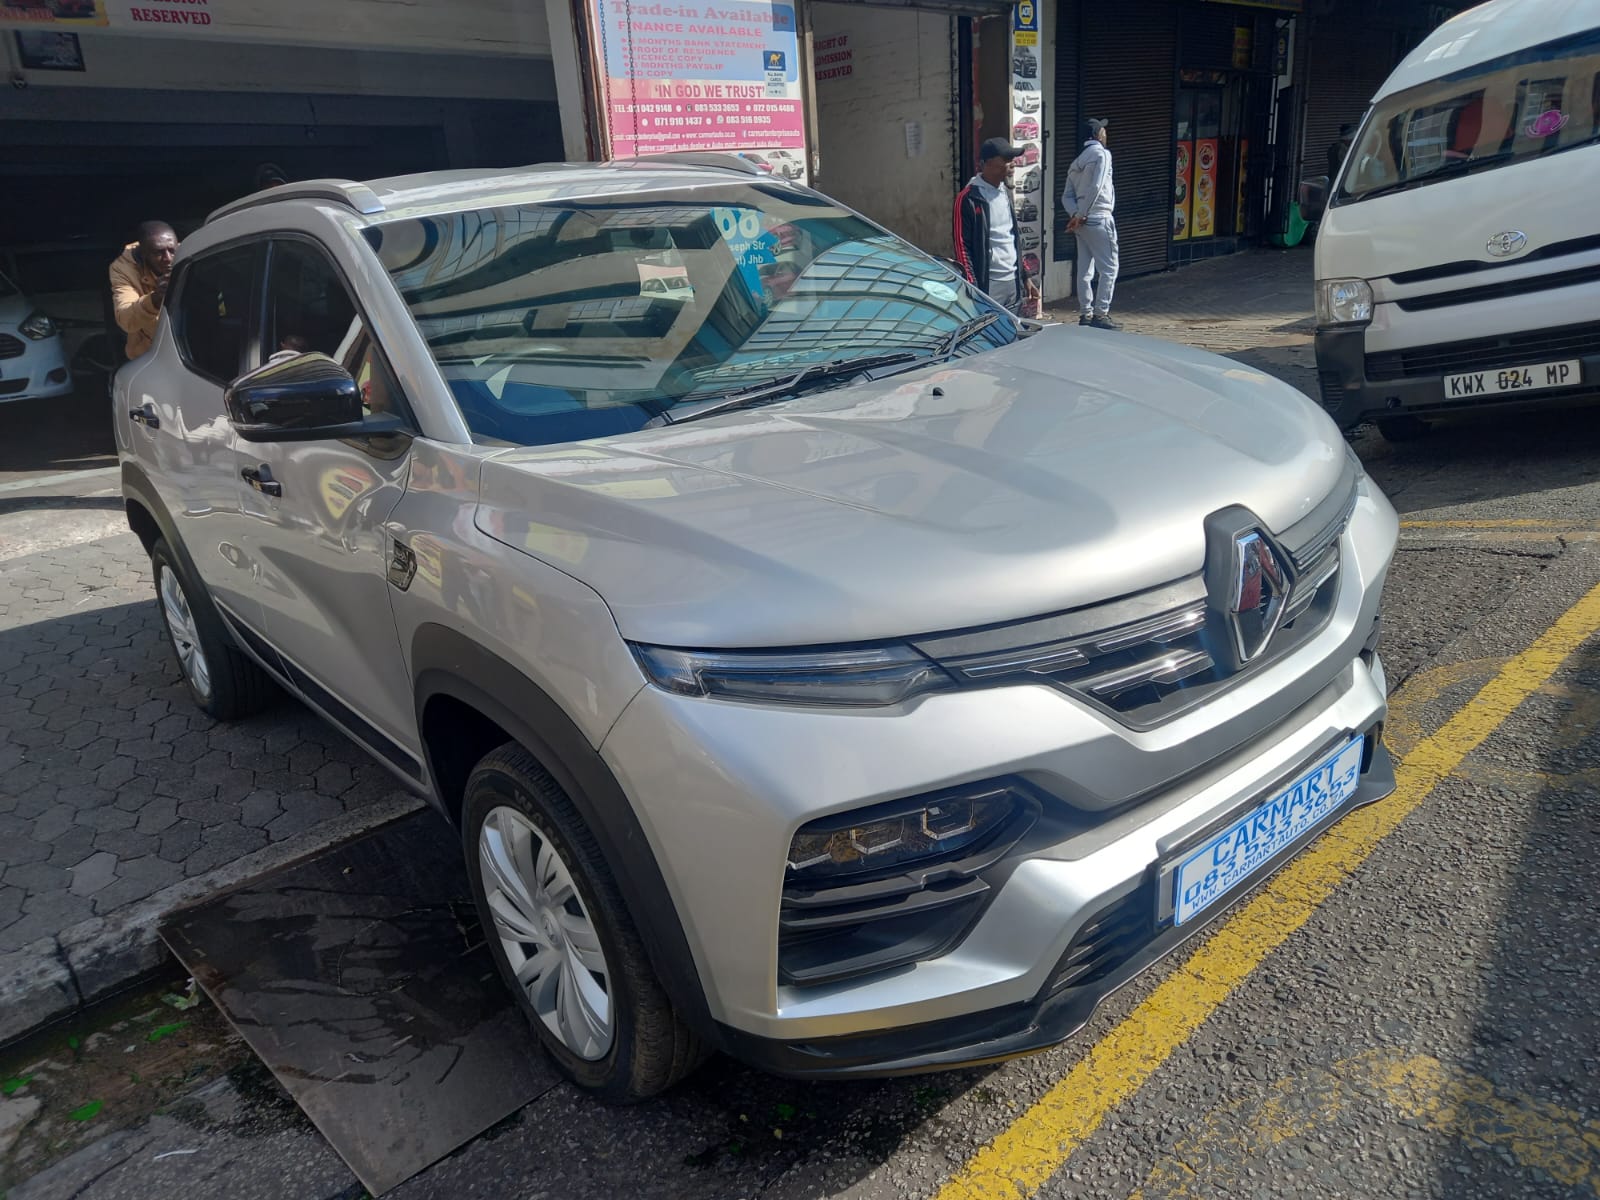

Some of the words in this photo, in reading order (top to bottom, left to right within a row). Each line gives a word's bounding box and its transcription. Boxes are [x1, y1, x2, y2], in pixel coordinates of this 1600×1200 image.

[130, 8, 211, 25] RESERVED
[704, 7, 789, 24] Available
[618, 21, 683, 32] FNANCE
[689, 25, 762, 37] AVAILABLE
[639, 38, 682, 46] MONTHS
[714, 41, 766, 50] STATEMENT
[838, 36, 848, 47] OF
[683, 48, 736, 56] RESIDENCE
[675, 85, 701, 97] GOD
[704, 85, 722, 97] WE
[728, 240, 750, 253] seph
[753, 240, 765, 250] Str
[748, 254, 763, 265] Jhb
[1451, 374, 1485, 396] KWX
[1546, 363, 1569, 384] MP
[1212, 758, 1339, 867] CARMART
[1184, 856, 1237, 905] 083
[1244, 815, 1292, 861] 533
[1299, 766, 1356, 820] 3653
